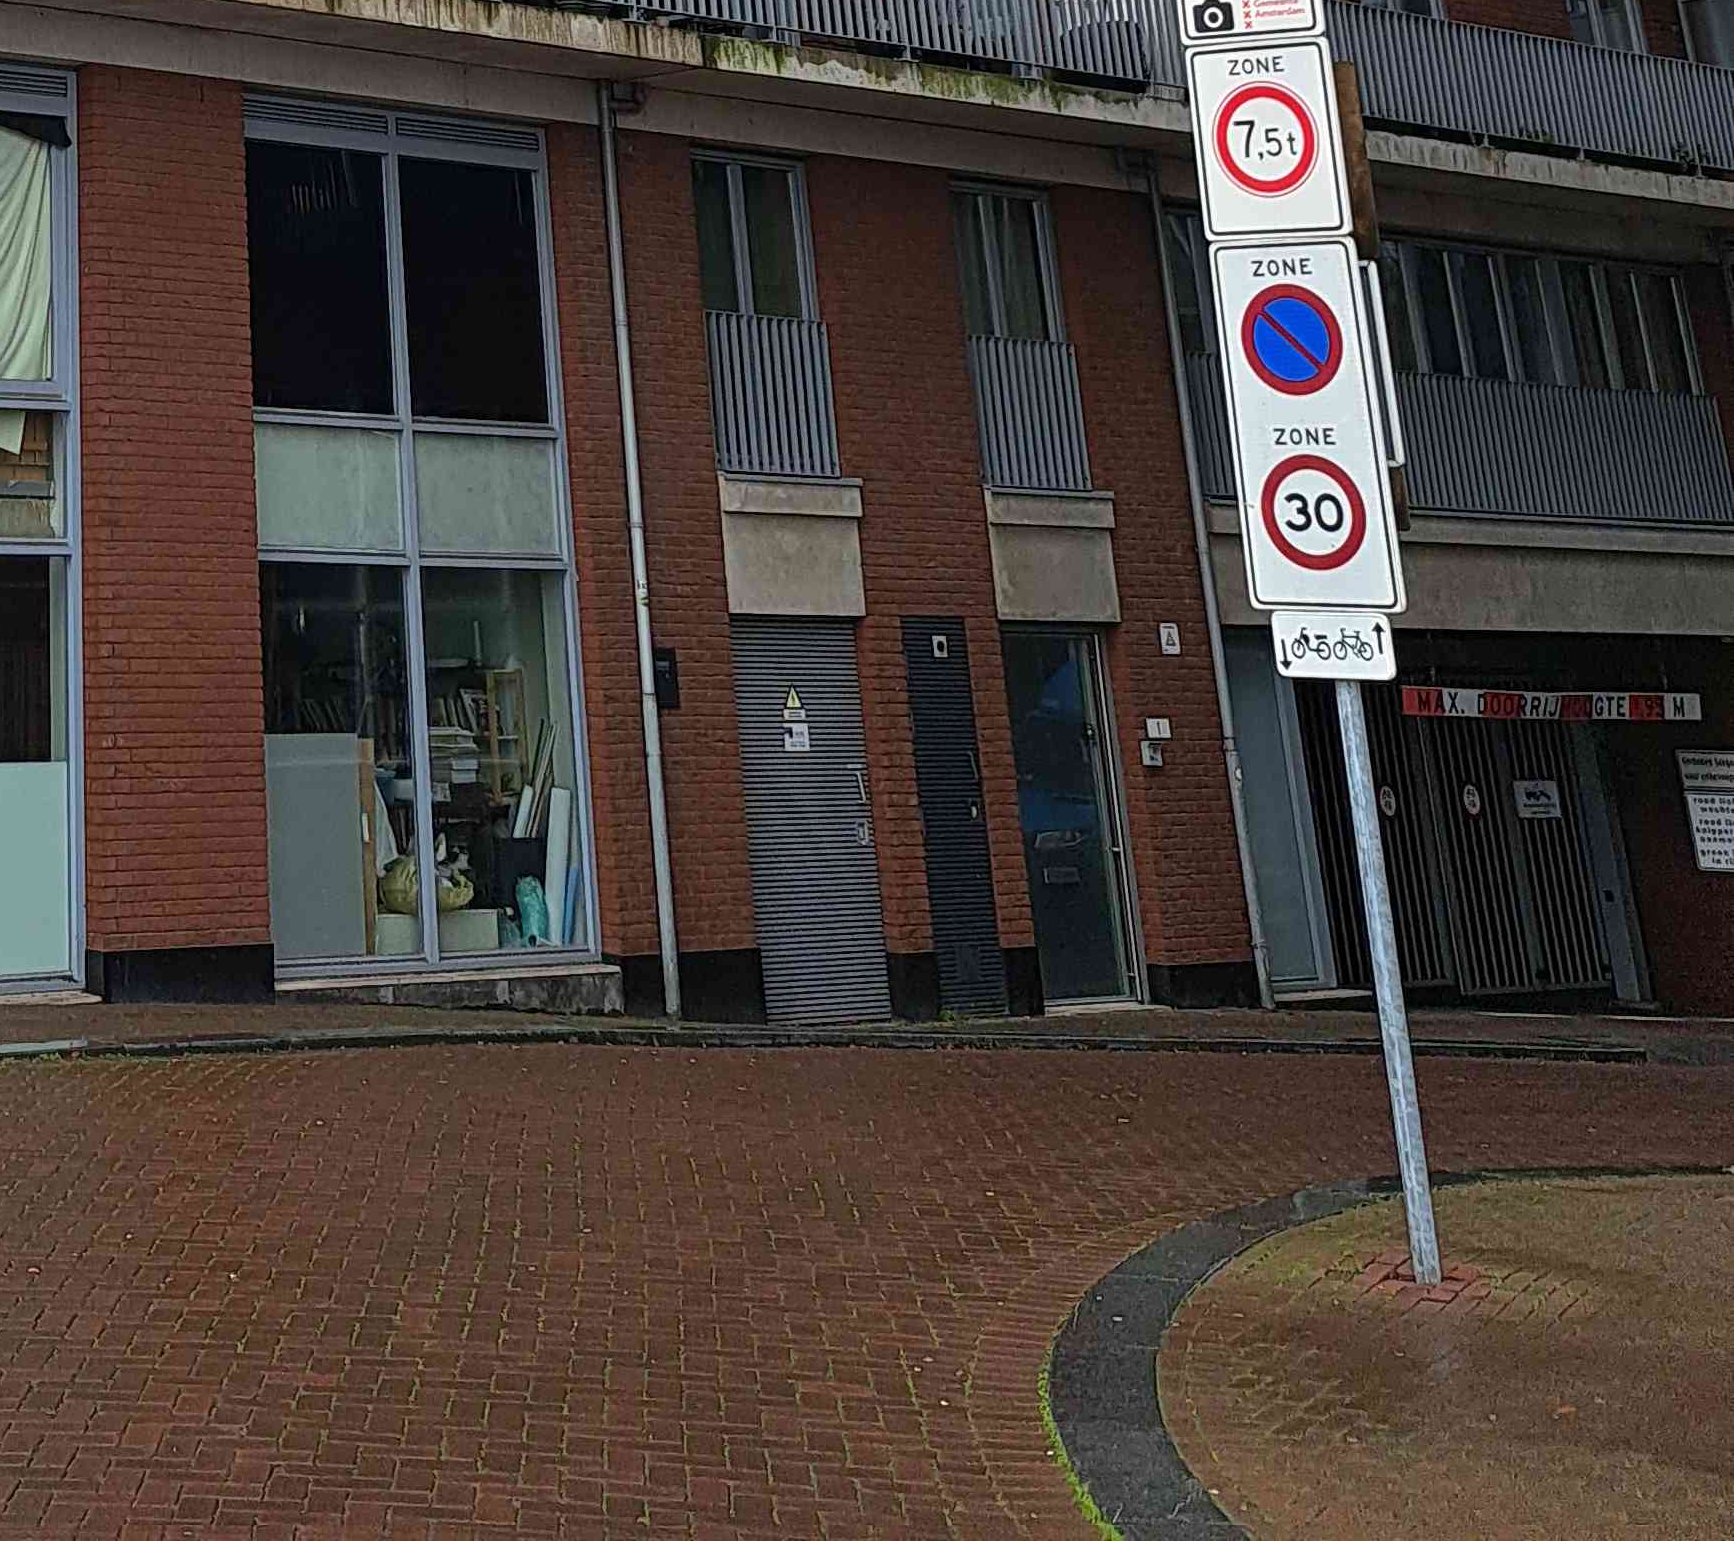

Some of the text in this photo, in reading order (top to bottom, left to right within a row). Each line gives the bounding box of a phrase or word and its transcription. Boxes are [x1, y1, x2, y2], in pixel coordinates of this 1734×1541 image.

[1255, 7, 1306, 18] Amsterdam
[1227, 55, 1284, 76] ZONE
[1251, 258, 1313, 277] ZONE
[1273, 428, 1337, 446] ZONE
[1284, 493, 1344, 532] 30
[1417, 691, 1465, 714] MAX.
[1477, 692, 1626, 718] DOORRIJOGTE
[1672, 696, 1685, 717] M
